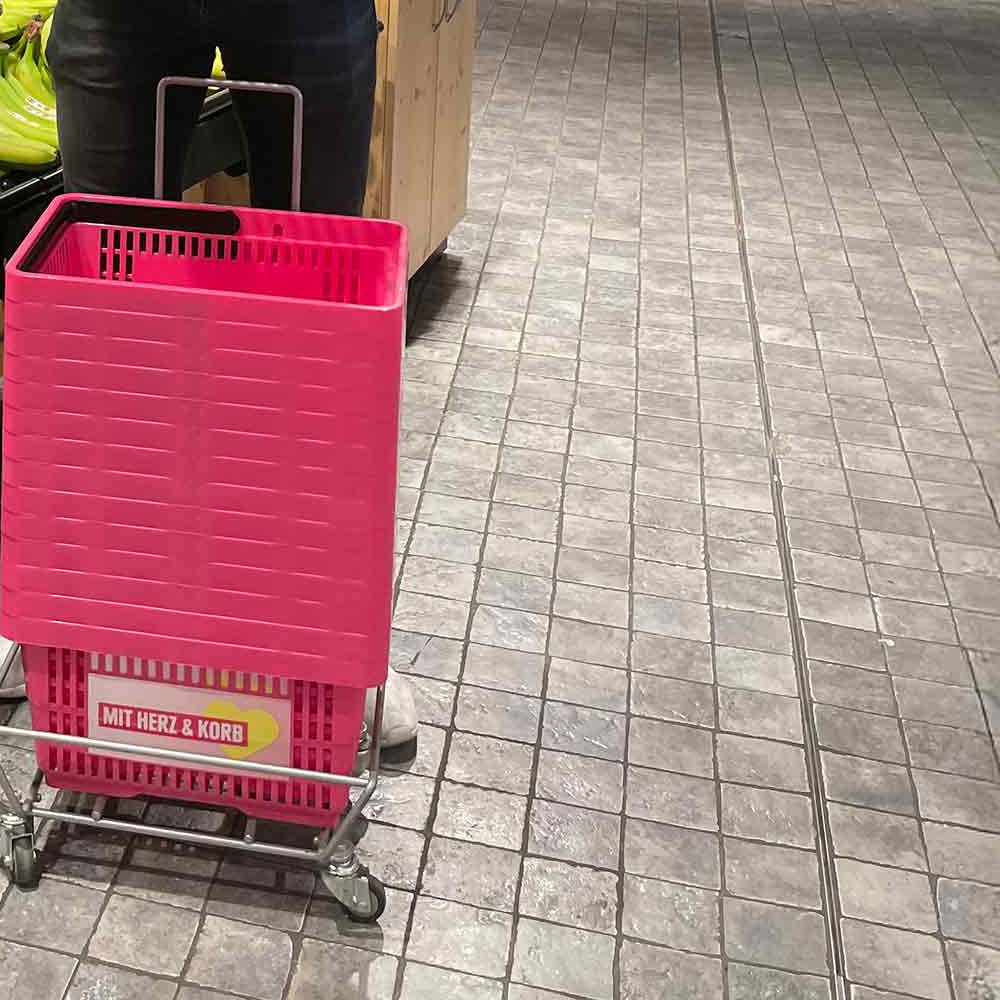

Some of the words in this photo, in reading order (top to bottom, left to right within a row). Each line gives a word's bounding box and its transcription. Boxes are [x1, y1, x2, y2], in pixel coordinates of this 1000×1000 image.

[103, 706, 134, 728] MIT
[137, 711, 178, 735] HERZ
[182, 718, 194, 737] &
[197, 719, 244, 743] KORB
